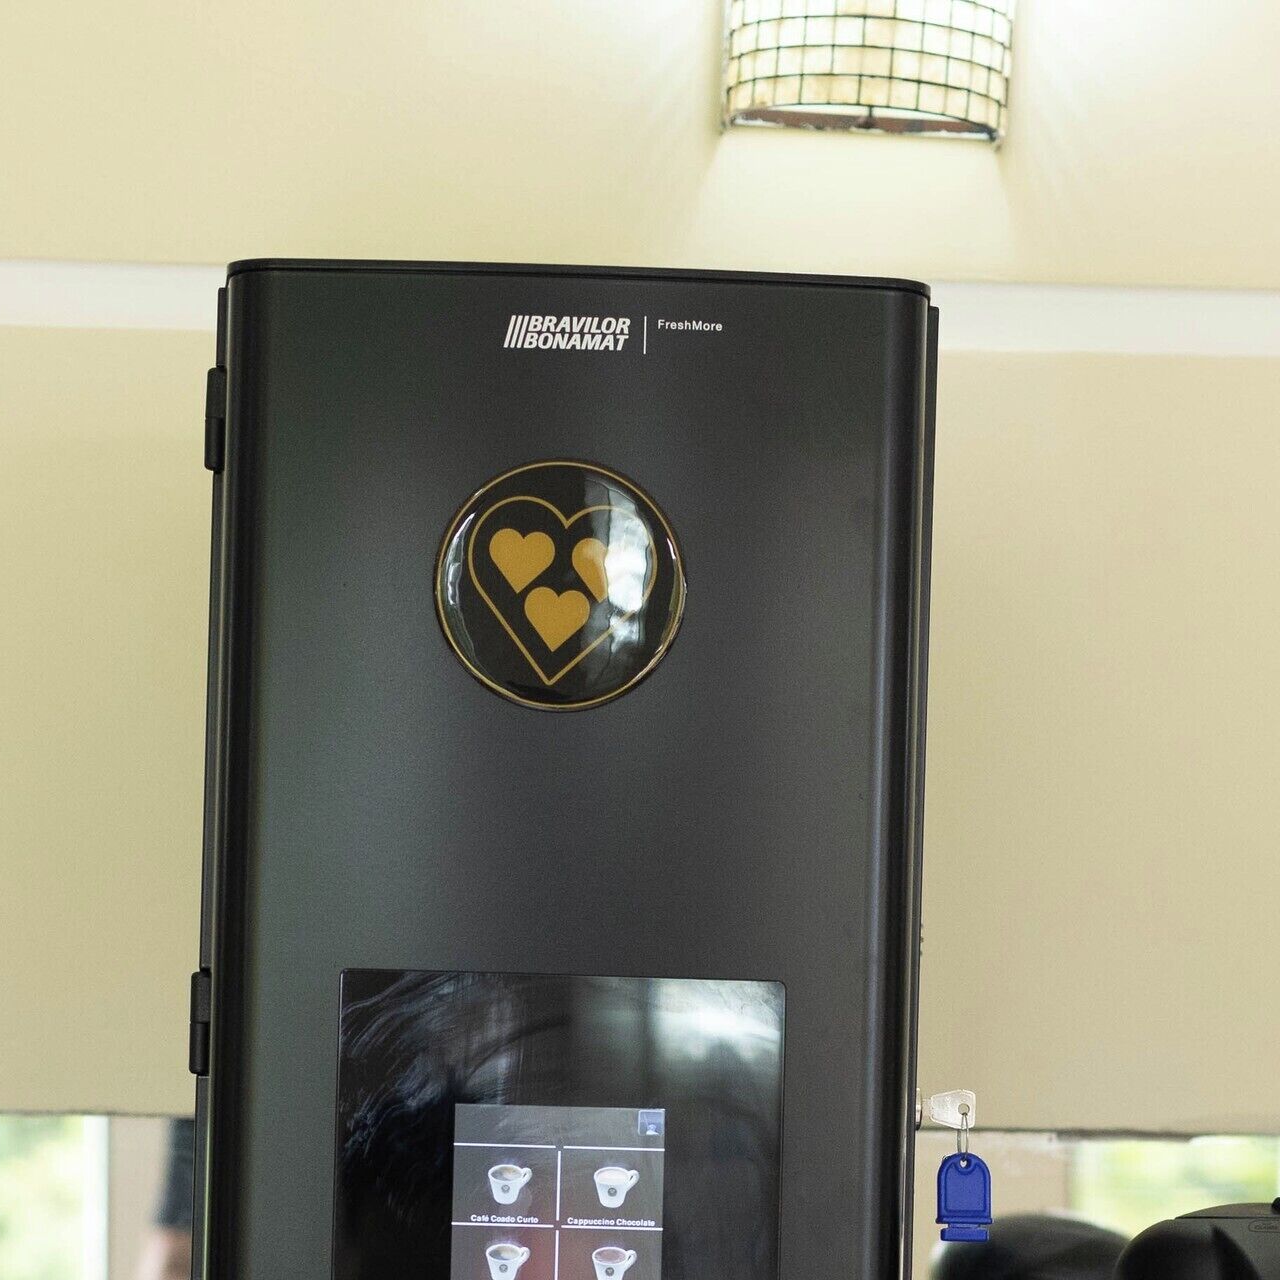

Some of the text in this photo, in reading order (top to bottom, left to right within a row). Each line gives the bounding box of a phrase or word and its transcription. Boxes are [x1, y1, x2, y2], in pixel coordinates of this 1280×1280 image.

[528, 315, 630, 334] BRAVILOR
[658, 319, 723, 331] FreshMore
[524, 333, 629, 351] BONAMAT
[470, 1214, 539, 1224] Café Coado Curto
[567, 1217, 655, 1227] Cappuccino Chocolate
